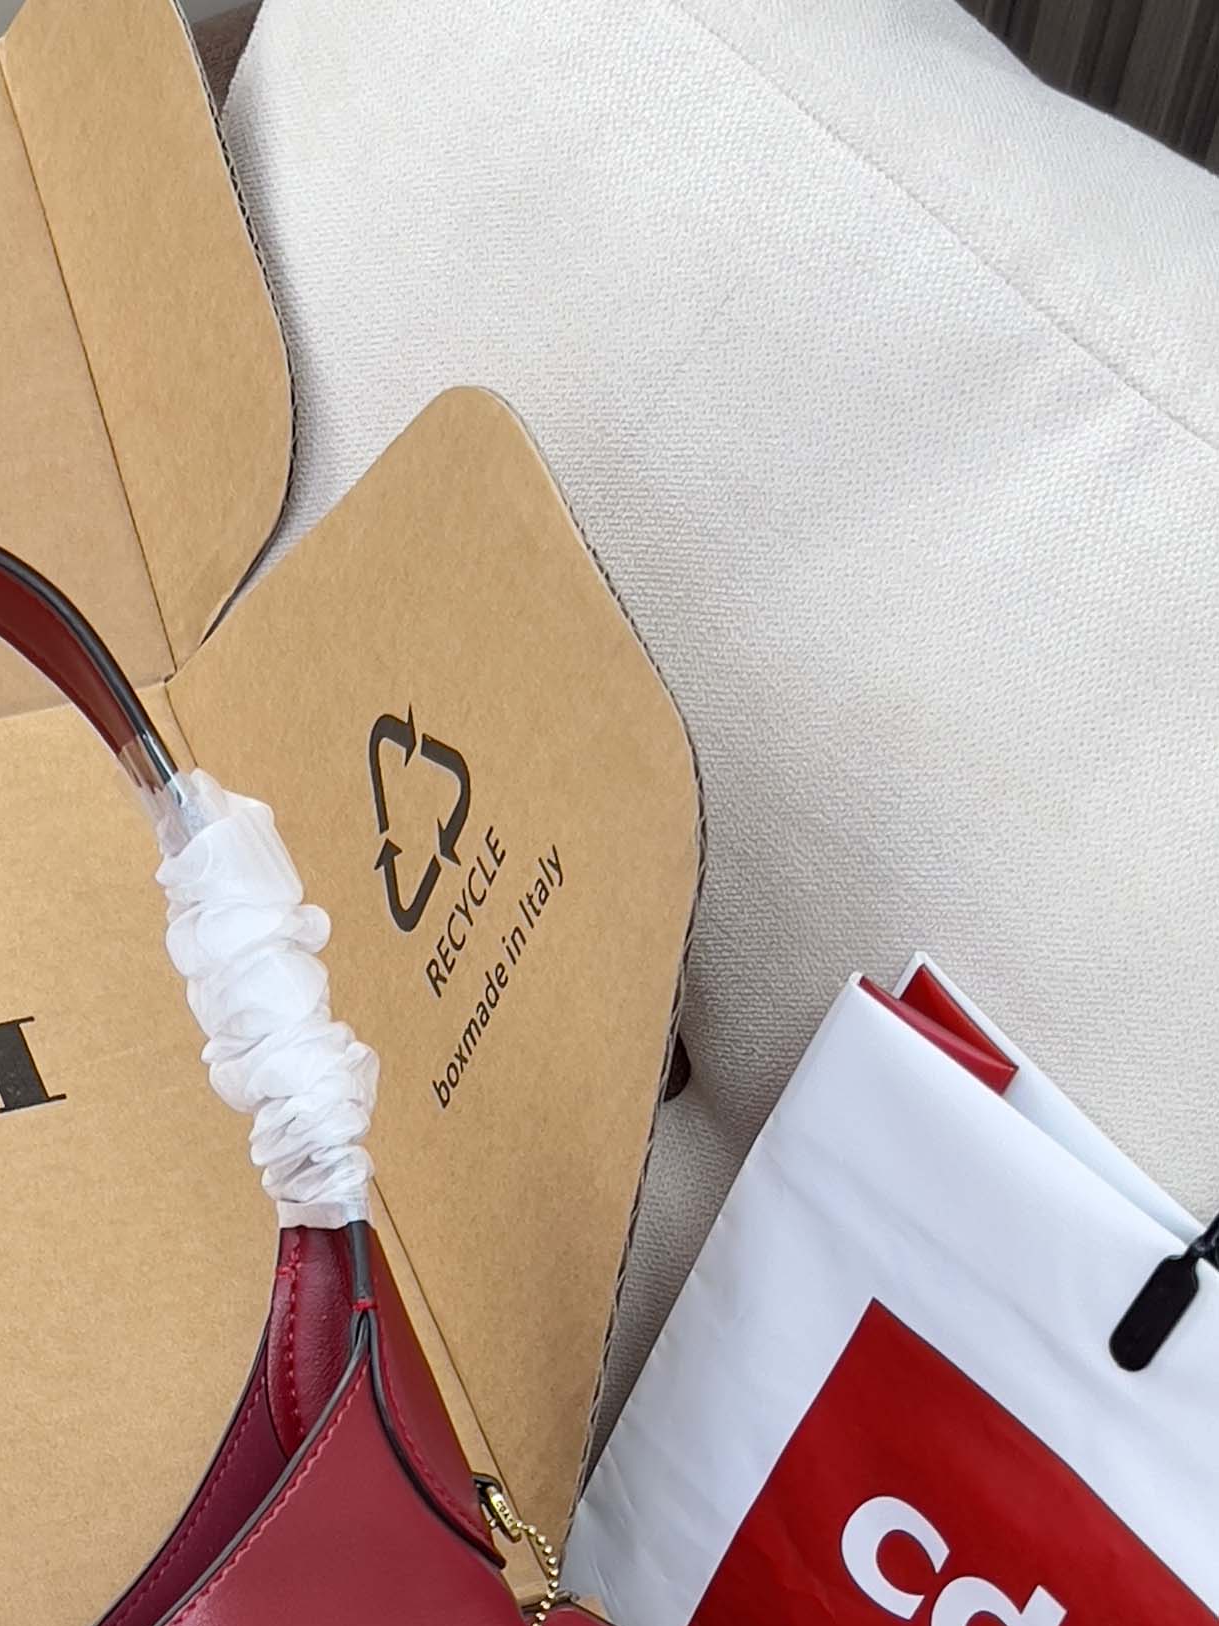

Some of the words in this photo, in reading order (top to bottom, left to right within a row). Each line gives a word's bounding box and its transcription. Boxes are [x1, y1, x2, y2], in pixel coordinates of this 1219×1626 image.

[424, 825, 507, 998] RECYCLE
[431, 961, 510, 1109] boxmade
[501, 924, 528, 966] in
[519, 843, 566, 930] Italy
